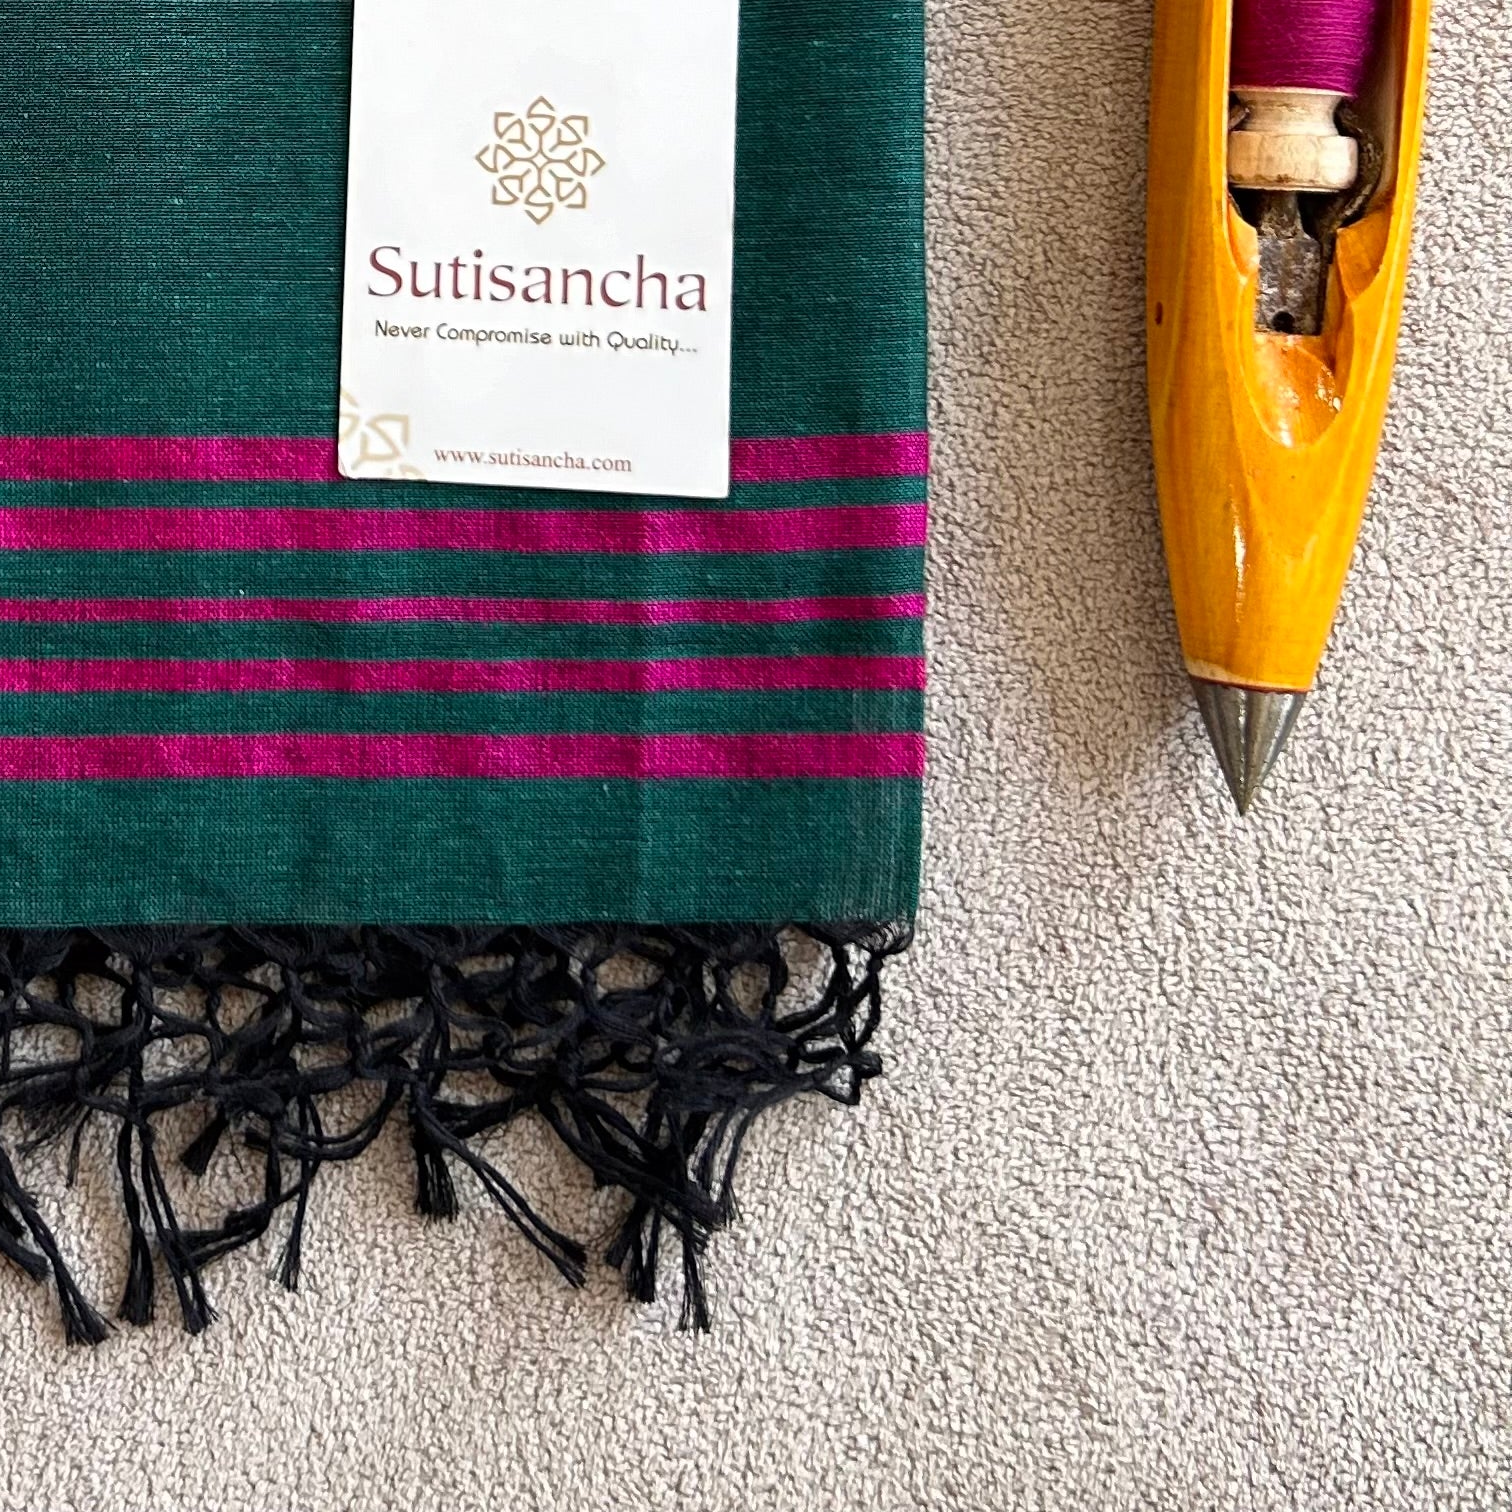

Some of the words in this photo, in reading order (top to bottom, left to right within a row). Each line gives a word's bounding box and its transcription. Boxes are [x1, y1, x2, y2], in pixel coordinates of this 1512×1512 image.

[368, 246, 706, 311] Sutisancha
[376, 320, 429, 338] Never
[436, 323, 552, 346] Compromise
[560, 331, 600, 347] with
[607, 331, 696, 356] Quality...
[435, 450, 631, 472] www.sutisancha.com
